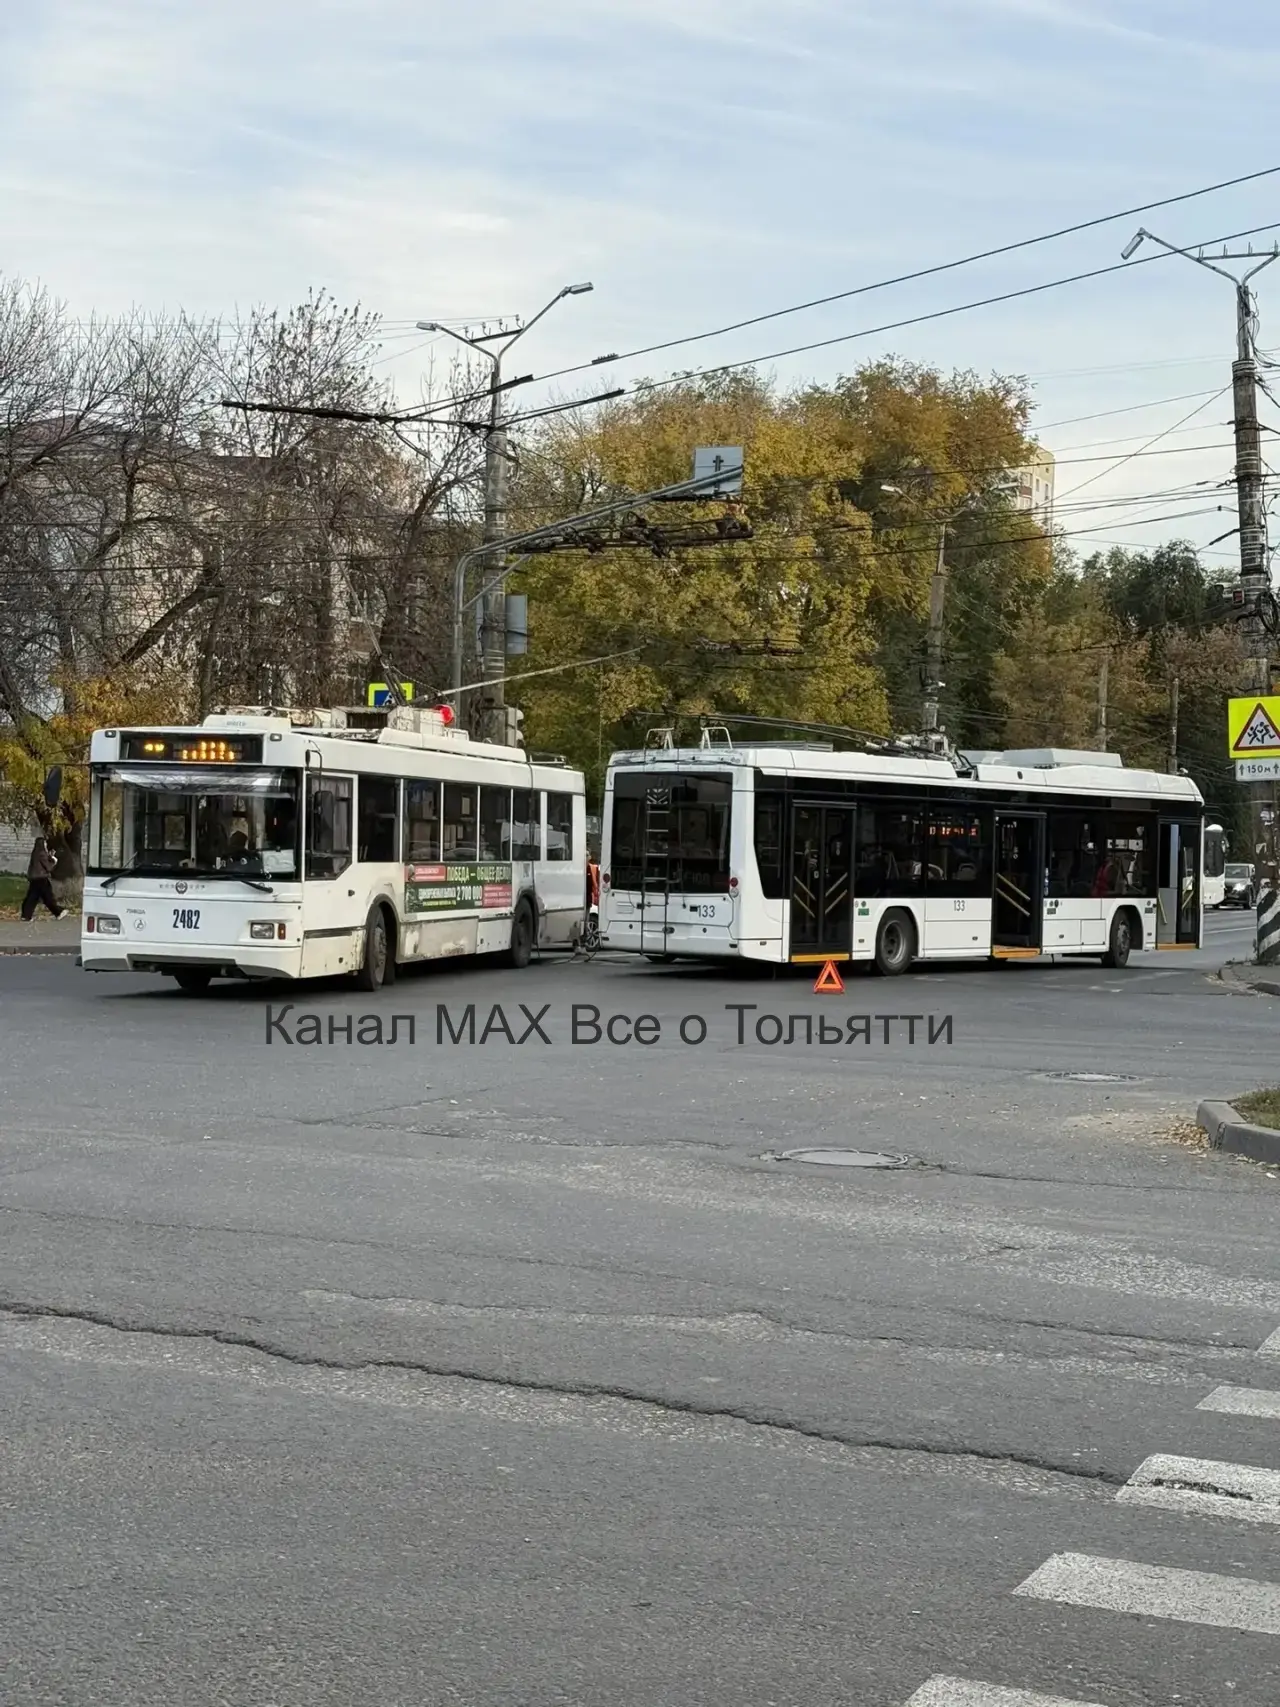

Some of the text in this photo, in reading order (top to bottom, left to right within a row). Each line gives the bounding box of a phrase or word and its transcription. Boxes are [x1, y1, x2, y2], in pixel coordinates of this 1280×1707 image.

[697, 905, 716, 918] 133
[953, 899, 966, 912] 133
[172, 908, 201, 930] 2482
